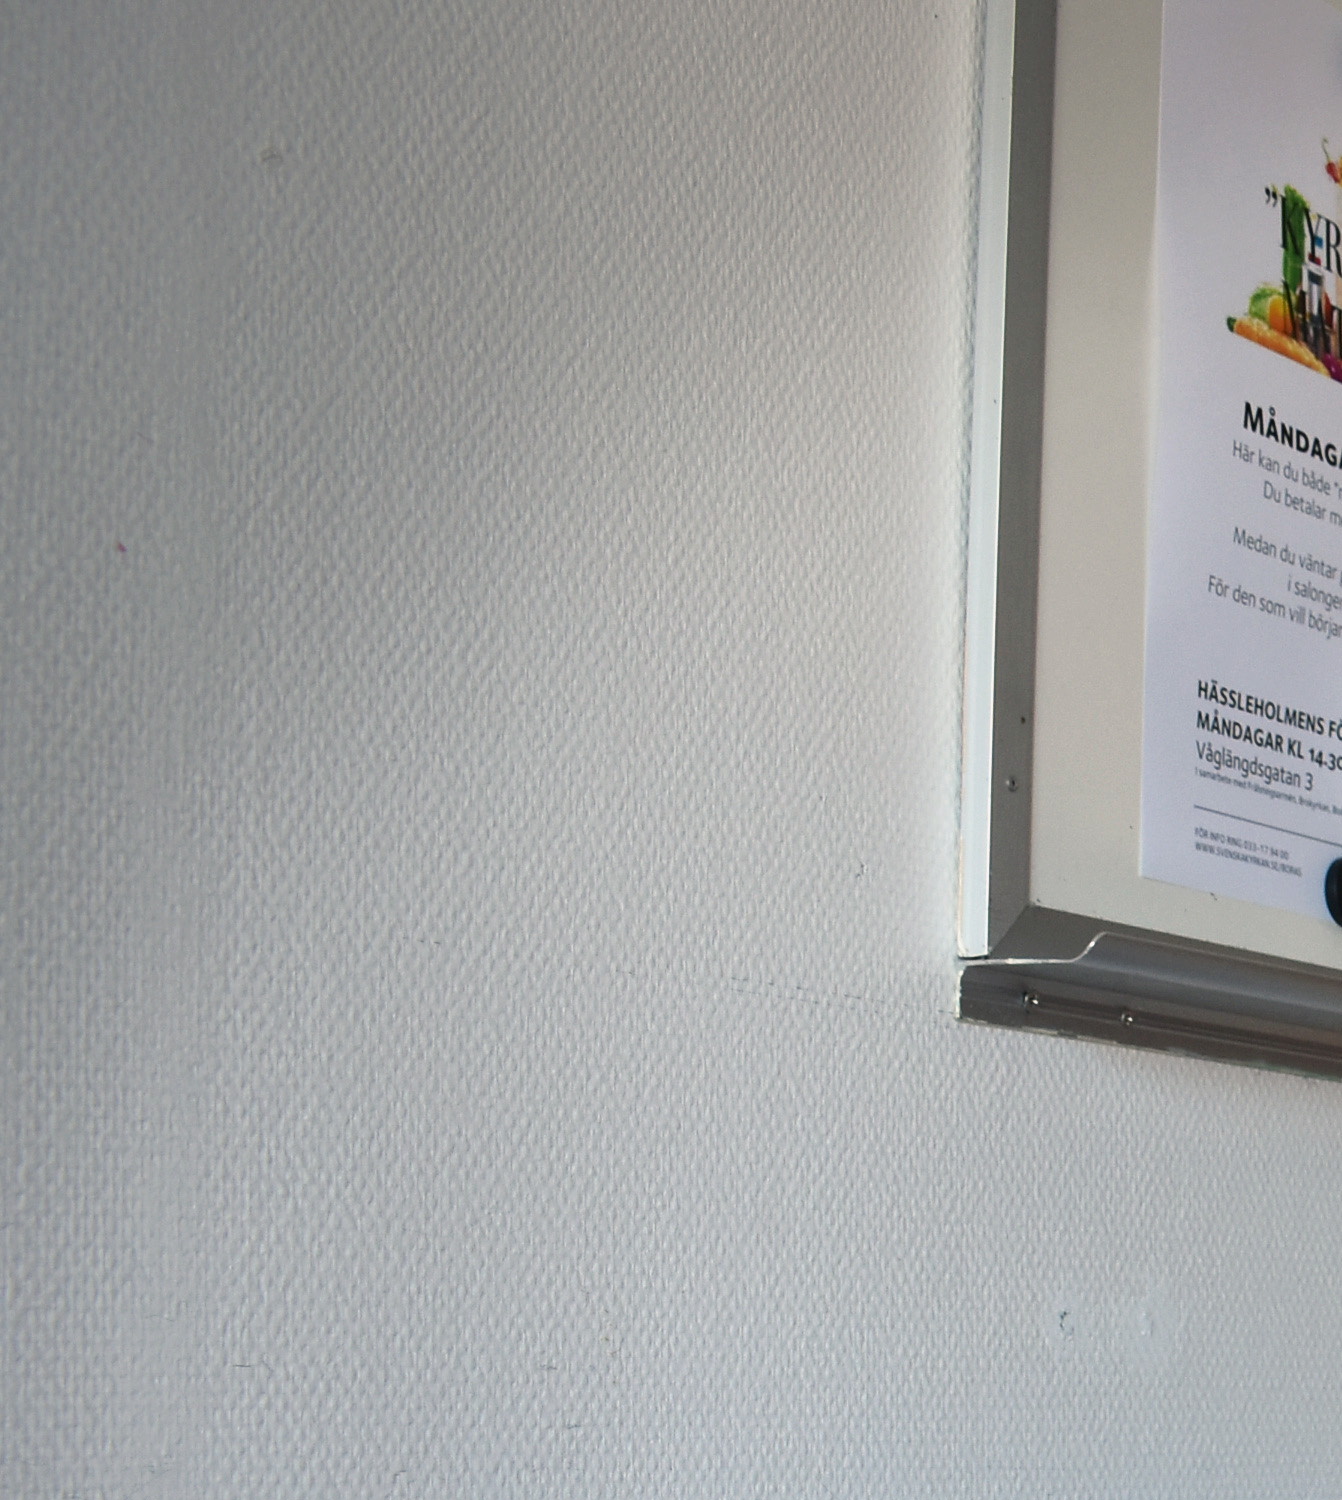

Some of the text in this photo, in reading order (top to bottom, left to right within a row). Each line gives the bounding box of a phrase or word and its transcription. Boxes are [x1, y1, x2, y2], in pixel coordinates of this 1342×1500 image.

[1233, 439, 1254, 463] Här
[1257, 451, 1279, 476] kan
[1282, 460, 1300, 484] du
[1302, 468, 1332, 496] både
[1263, 480, 1281, 503] Du
[1284, 489, 1326, 520] betalar
[1233, 527, 1277, 557] Medan
[1280, 544, 1297, 566] du
[1299, 551, 1337, 581] väntar
[1207, 574, 1230, 598] För
[1232, 583, 1256, 608] den
[1259, 597, 1287, 619] som
[1289, 601, 1307, 625] vill
[1308, 609, 1342, 642] börjar
[1198, 679, 1325, 736] HÄSSLEHOLMENS
[1196, 710, 1284, 753] MÅNDAGAR
[1287, 737, 1305, 760] KL
[1195, 741, 1314, 792] Våglängdsgatan 3
